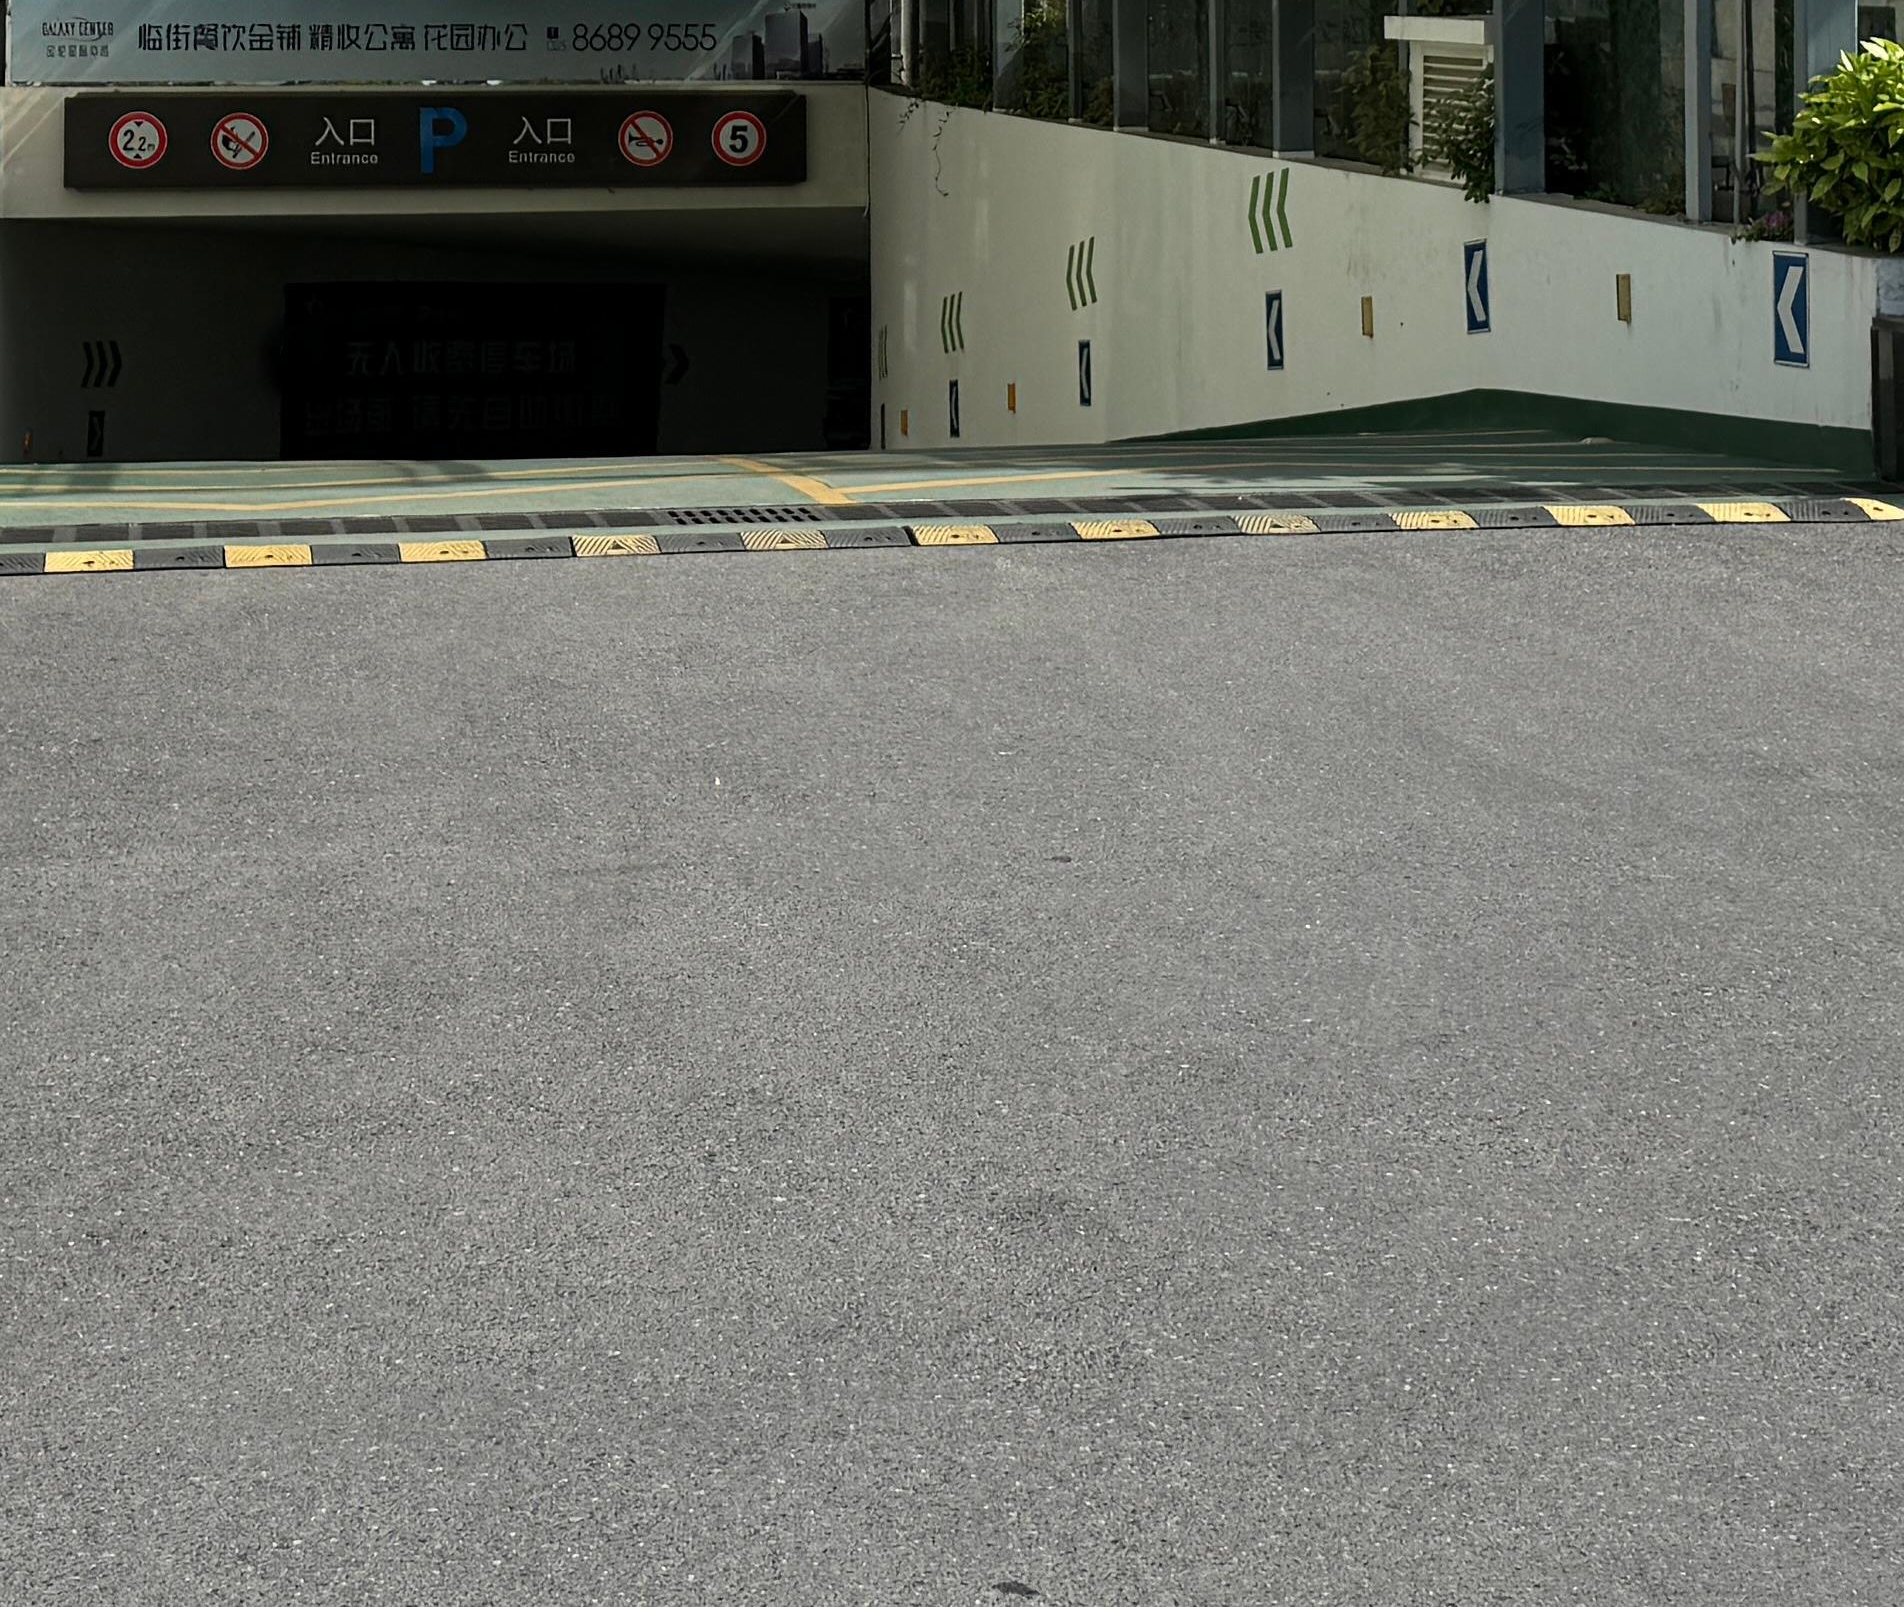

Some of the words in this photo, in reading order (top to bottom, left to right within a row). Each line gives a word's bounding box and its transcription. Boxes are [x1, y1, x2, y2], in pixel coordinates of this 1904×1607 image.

[424, 23, 528, 51] 花园办公
[572, 23, 641, 51] 8689
[647, 23, 717, 51] 9555
[314, 116, 375, 146] 入口
[419, 107, 468, 174] P
[512, 116, 572, 145] 入口
[729, 125, 749, 153] 5
[310, 152, 378, 165] Entrance
[509, 151, 576, 164] Entrance
